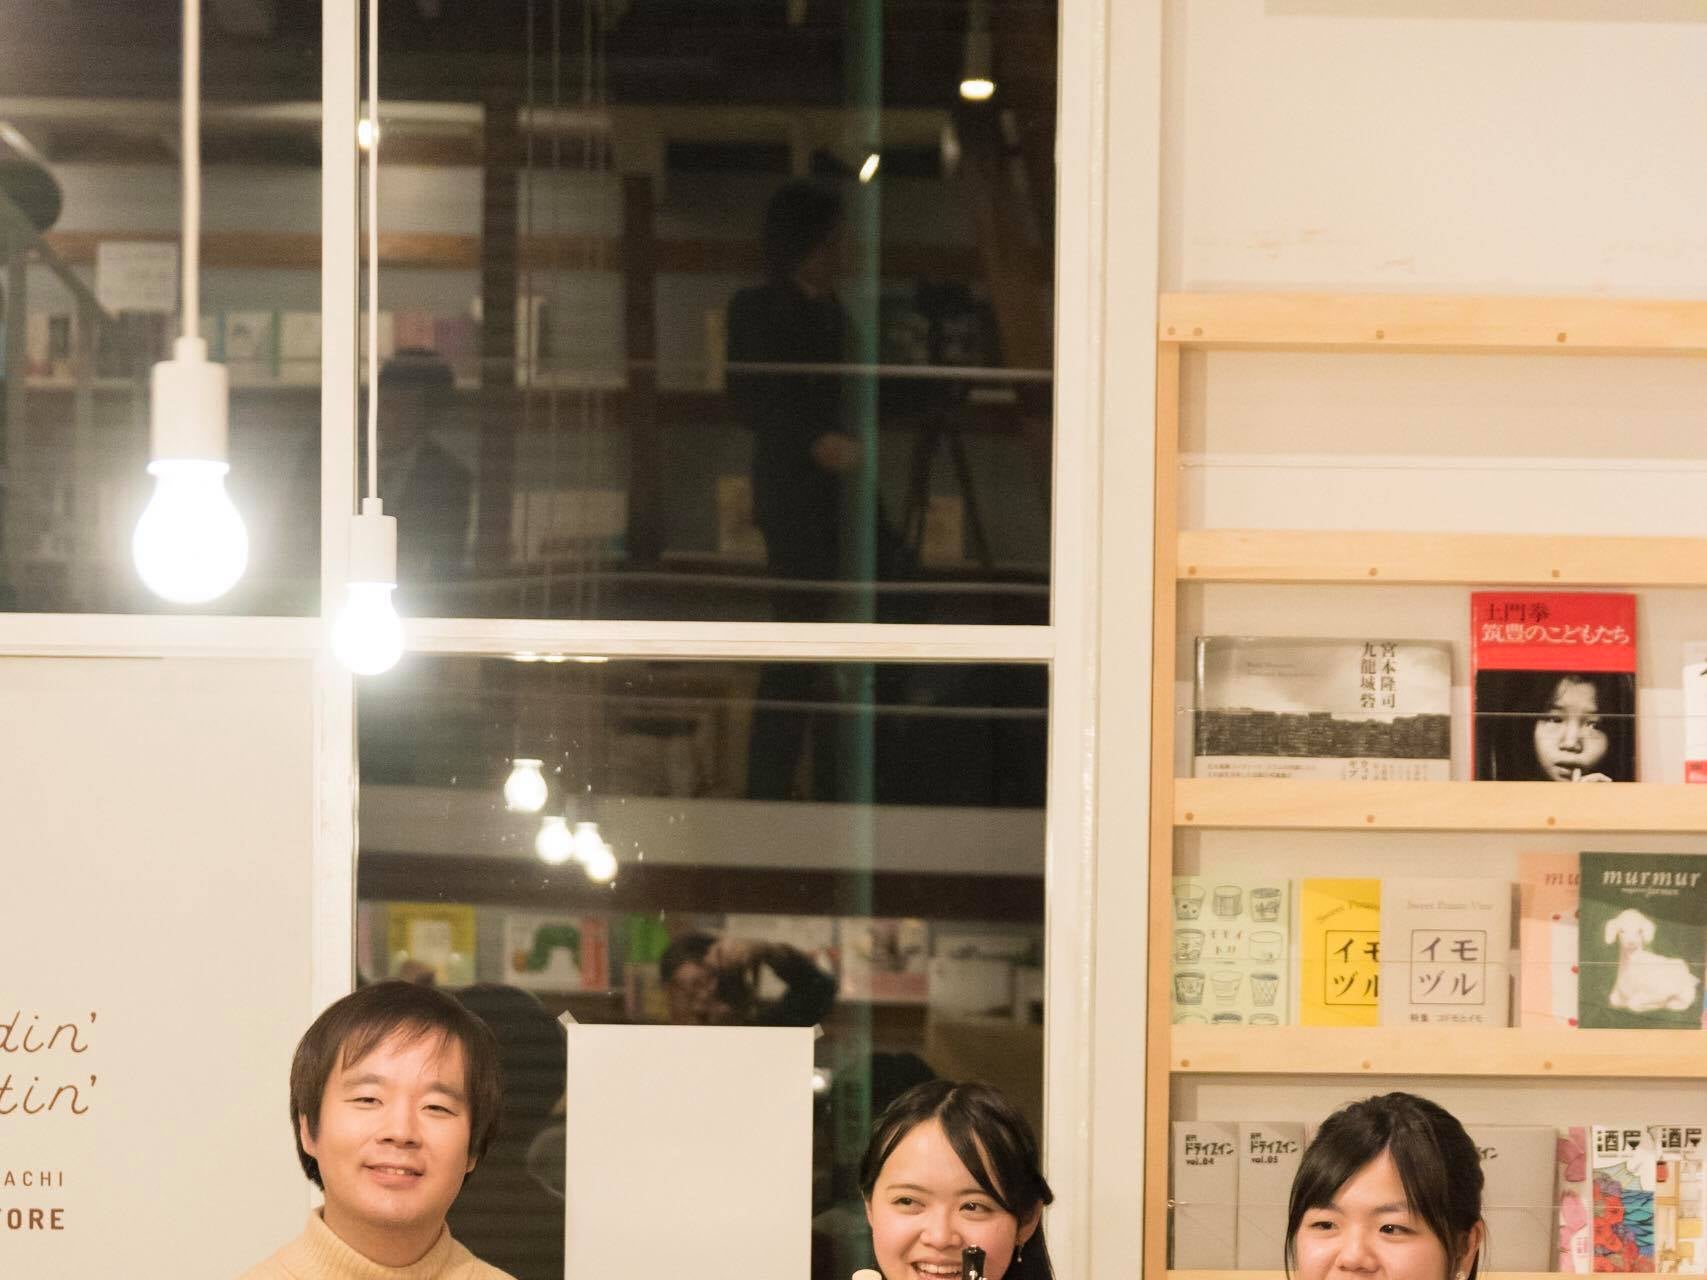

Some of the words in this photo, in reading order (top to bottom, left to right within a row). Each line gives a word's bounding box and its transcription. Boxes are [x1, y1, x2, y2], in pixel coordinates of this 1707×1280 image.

[1481, 623, 1631, 644] 筑豊のこどもたち
[1380, 641, 1398, 708] 宮本隆司
[1602, 870, 1701, 887] murmur
[1419, 936, 1479, 962] イモ
[4, 1171, 64, 1187] ACHI
[0, 1208, 65, 1230] ORE
